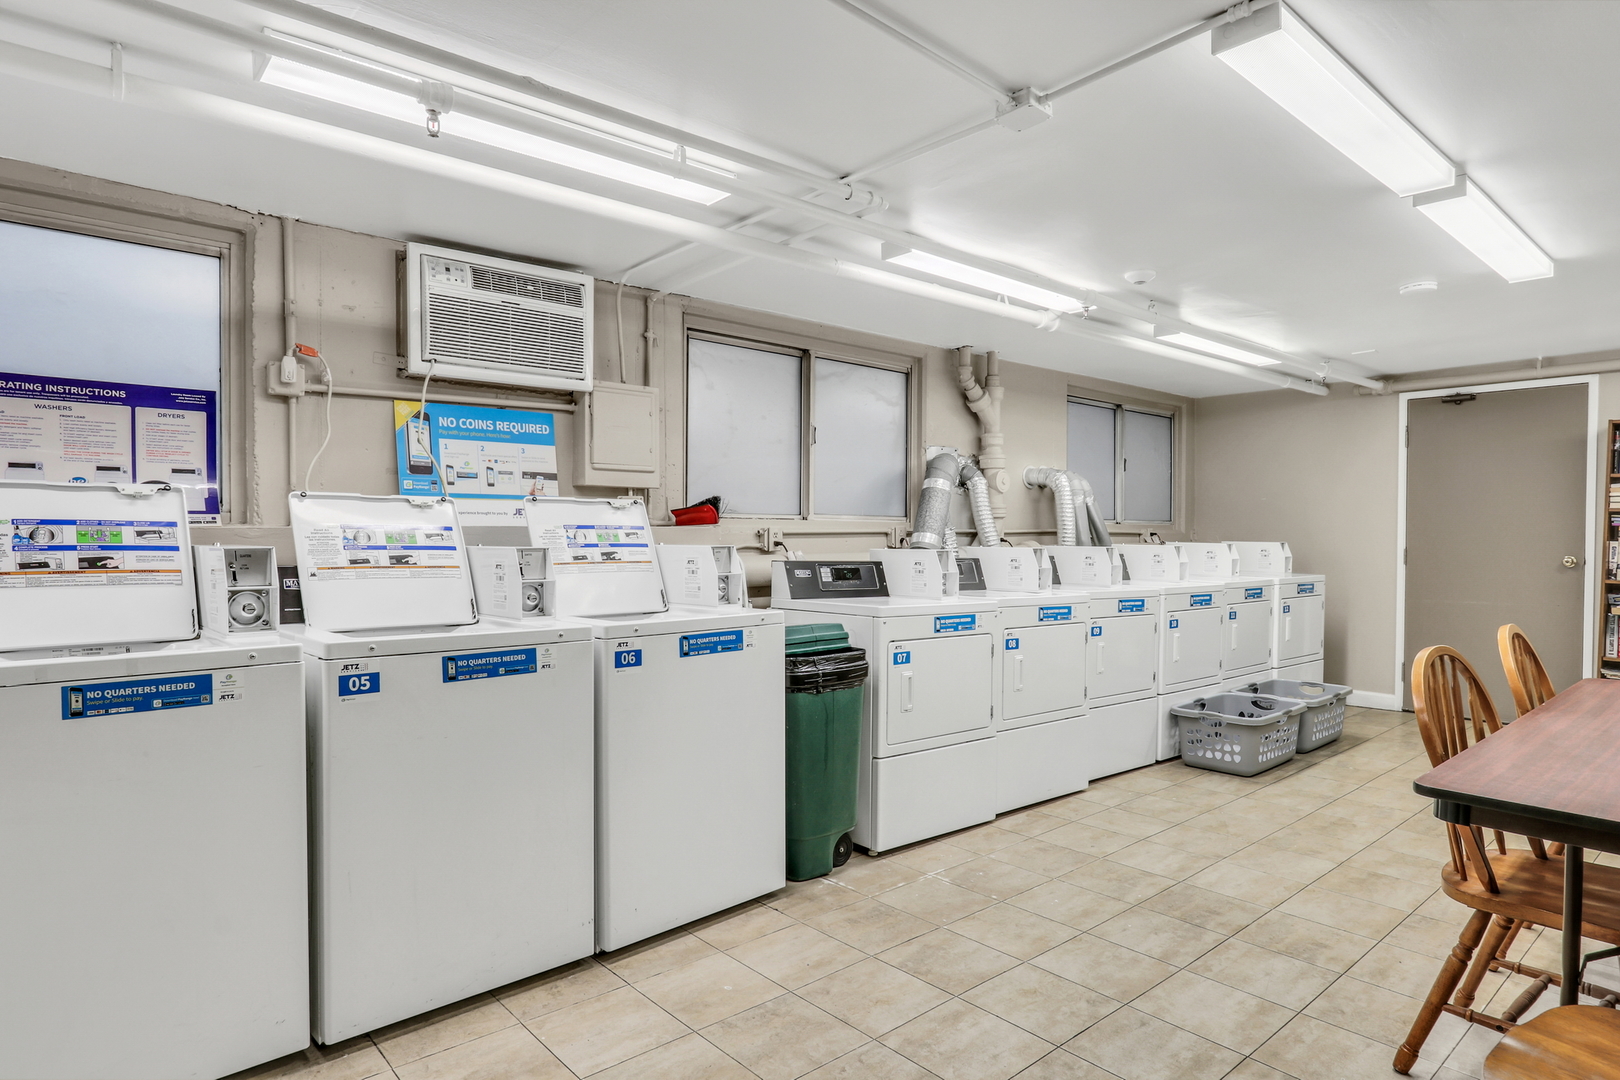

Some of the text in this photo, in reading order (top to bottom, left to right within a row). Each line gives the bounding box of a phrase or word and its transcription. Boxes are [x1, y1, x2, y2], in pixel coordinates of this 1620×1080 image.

[46, 385, 126, 398] INSTRUCTIONS
[439, 417, 456, 428] NO
[459, 418, 494, 431] COINS
[496, 421, 550, 435] REQUIRED
[1009, 640, 1016, 648] 08
[468, 657, 501, 666] QUARTERS
[621, 652, 636, 664] 06
[897, 654, 907, 662] 07
[349, 676, 370, 692] 05
[87, 682, 196, 699] NO QUARTERS NEEDED
